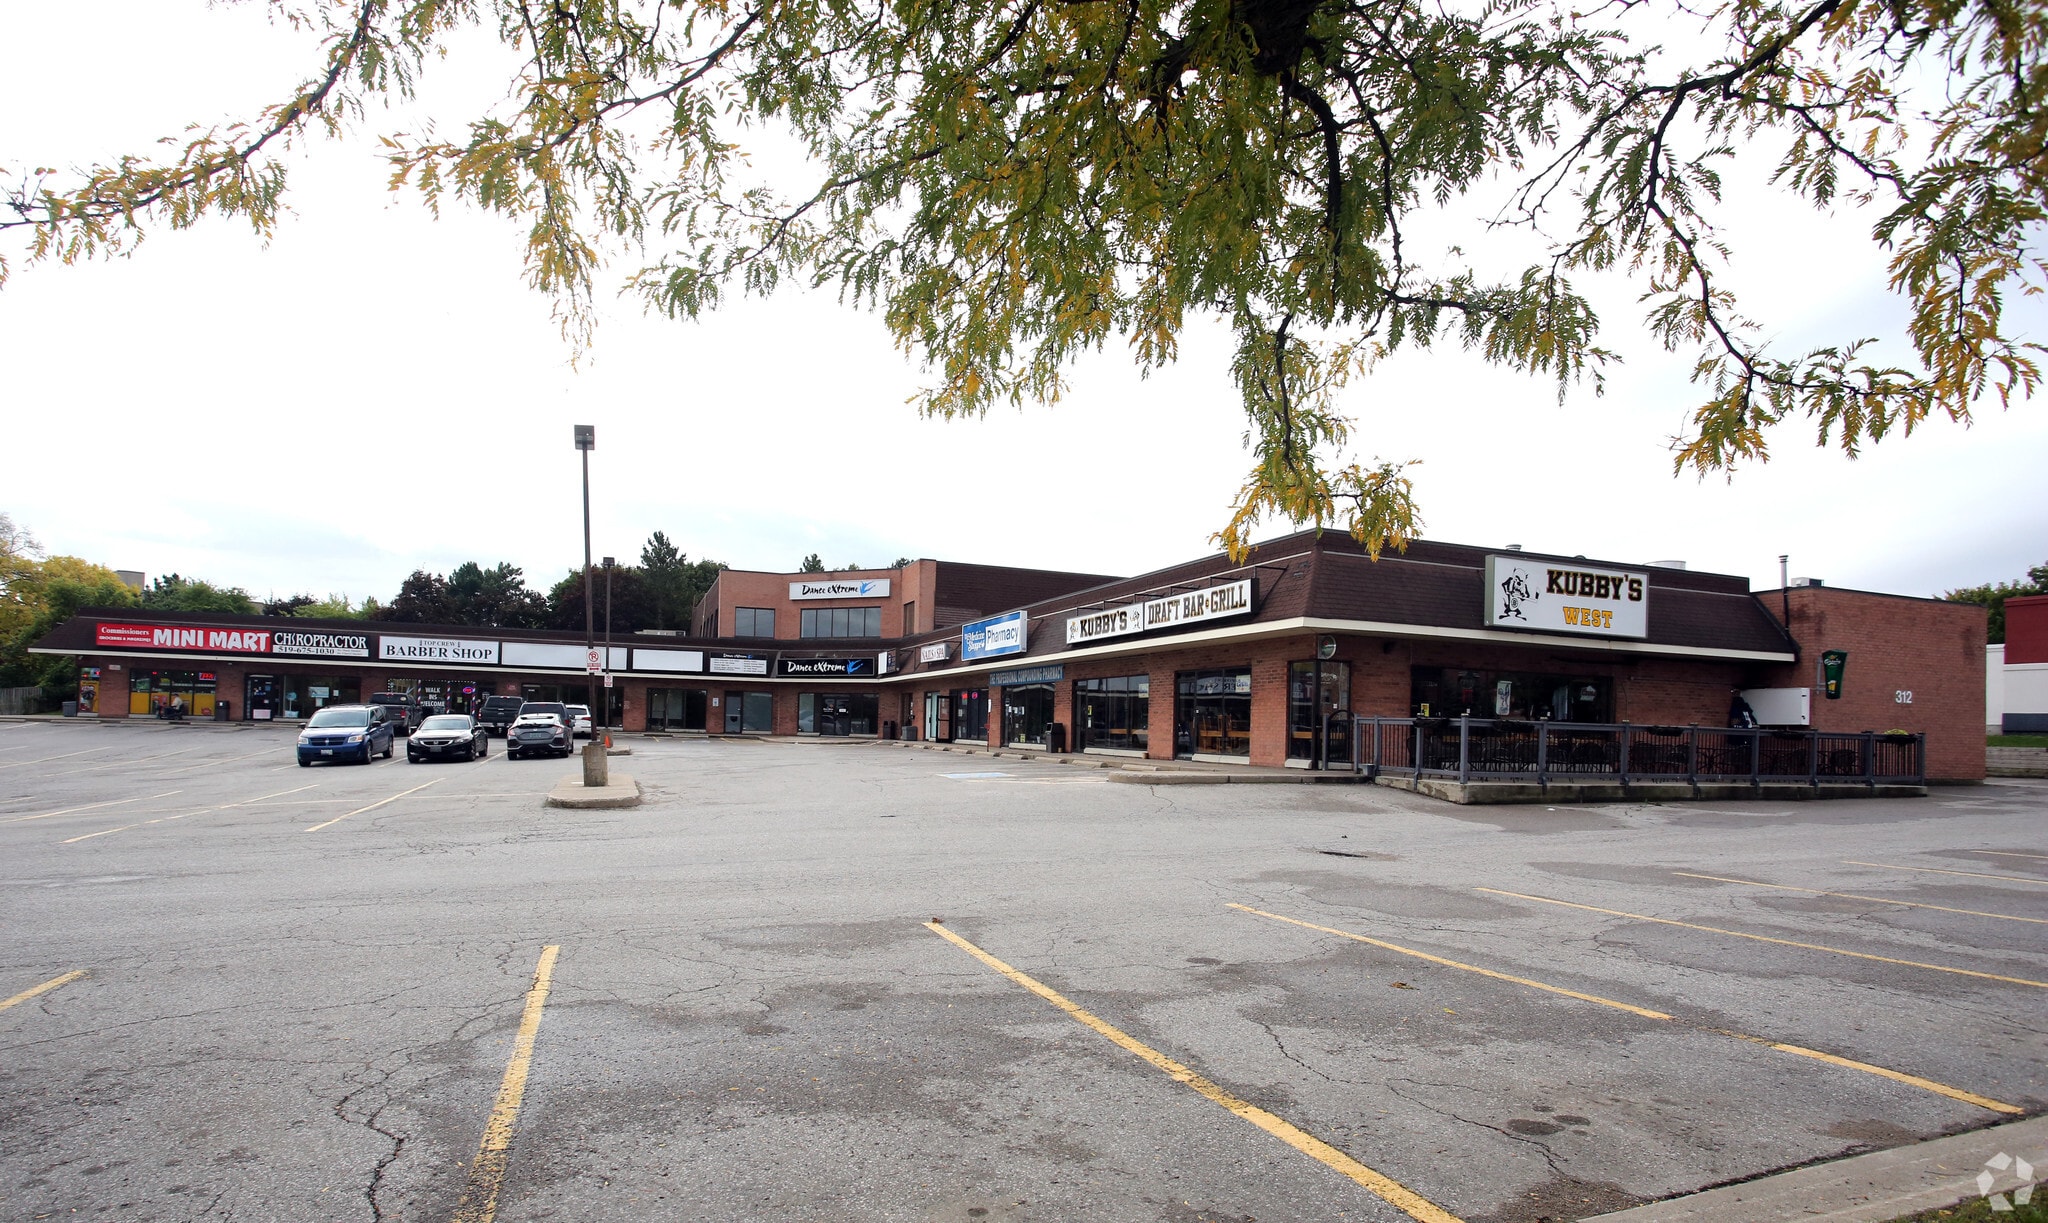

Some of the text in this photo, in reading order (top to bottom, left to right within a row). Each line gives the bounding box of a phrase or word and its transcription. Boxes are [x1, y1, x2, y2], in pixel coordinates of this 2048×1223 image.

[802, 583, 859, 595] Dance eXtreme
[1546, 569, 1642, 601] KUBBY'S
[1147, 585, 1247, 625] DRAFT BAR GRILL
[1079, 610, 1128, 638] KUBBY'S
[1563, 606, 1613, 629] WEST
[101, 626, 150, 636] Commissioners
[987, 627, 1019, 643] Pharmacy
[153, 628, 270, 652] MINI MART
[274, 632, 367, 649] CHIROPRACTOR
[278, 646, 334, 654] 519-675-1030
[386, 645, 493, 660] BARBER SHOP
[787, 661, 846, 673] Dance eXtreme
[1043, 666, 1063, 680] PHARMACY
[1895, 690, 1913, 704] 312
